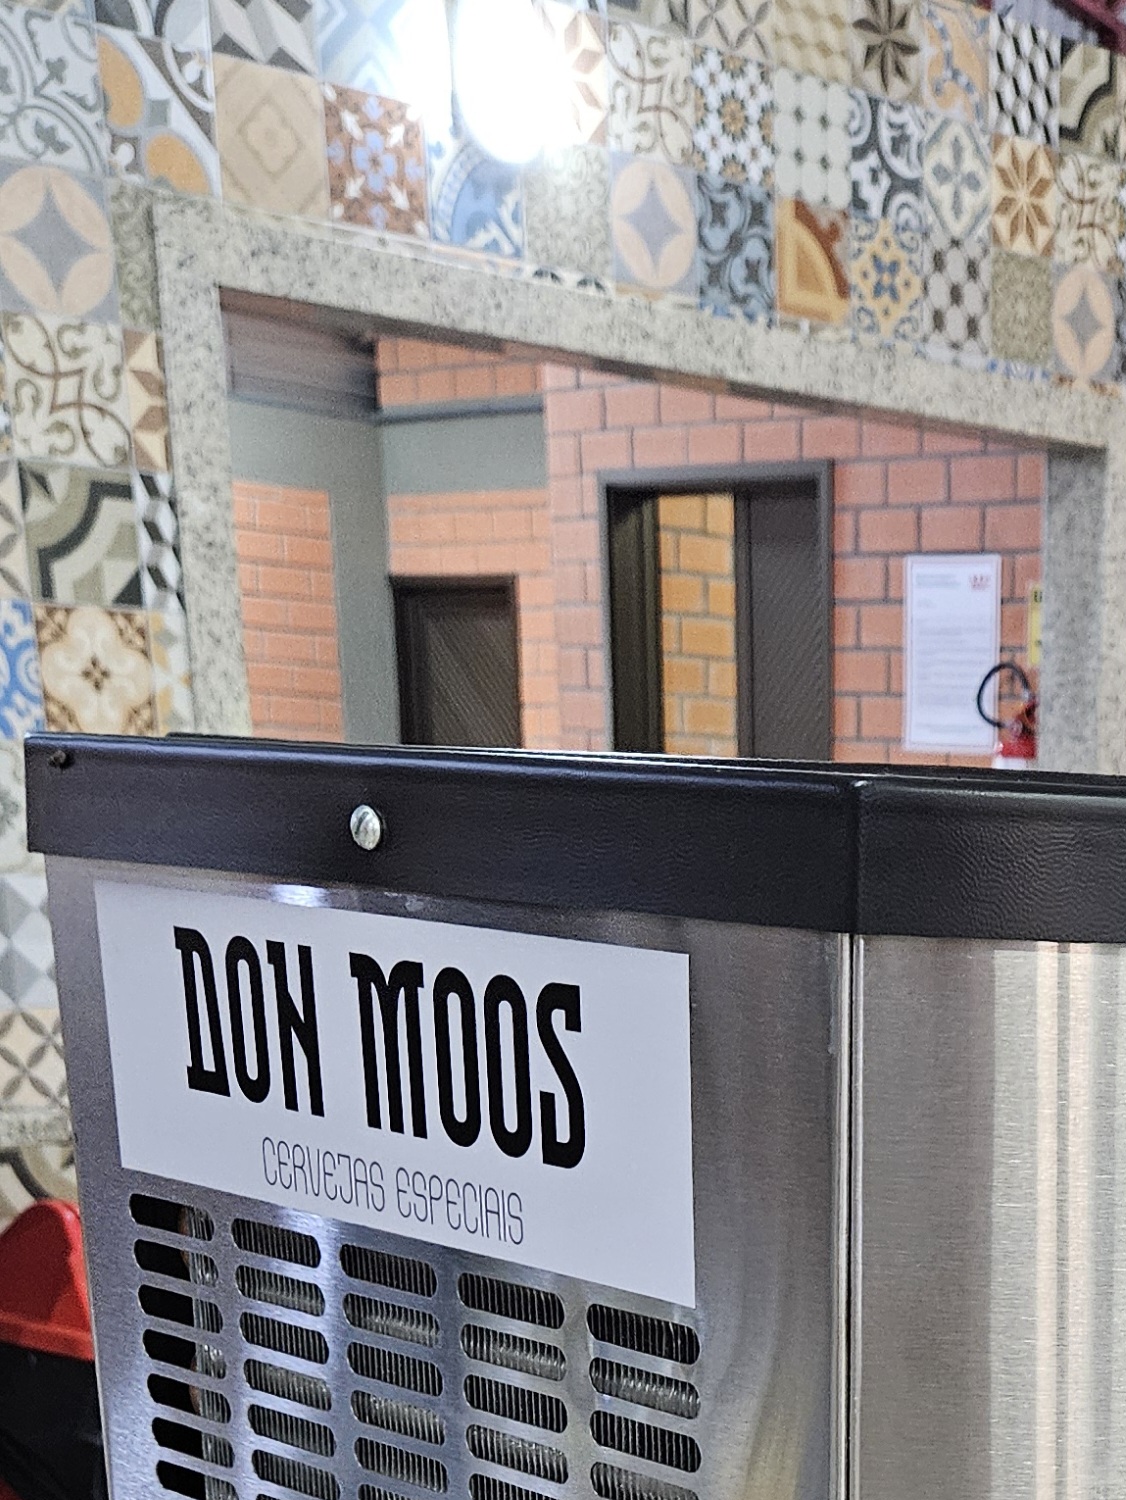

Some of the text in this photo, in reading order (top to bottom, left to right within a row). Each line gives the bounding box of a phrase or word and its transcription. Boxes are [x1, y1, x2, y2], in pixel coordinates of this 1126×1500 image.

[173, 925, 586, 1169] DON MOOS
[262, 1137, 524, 1246] CERVEJAS ESPECIAIS
